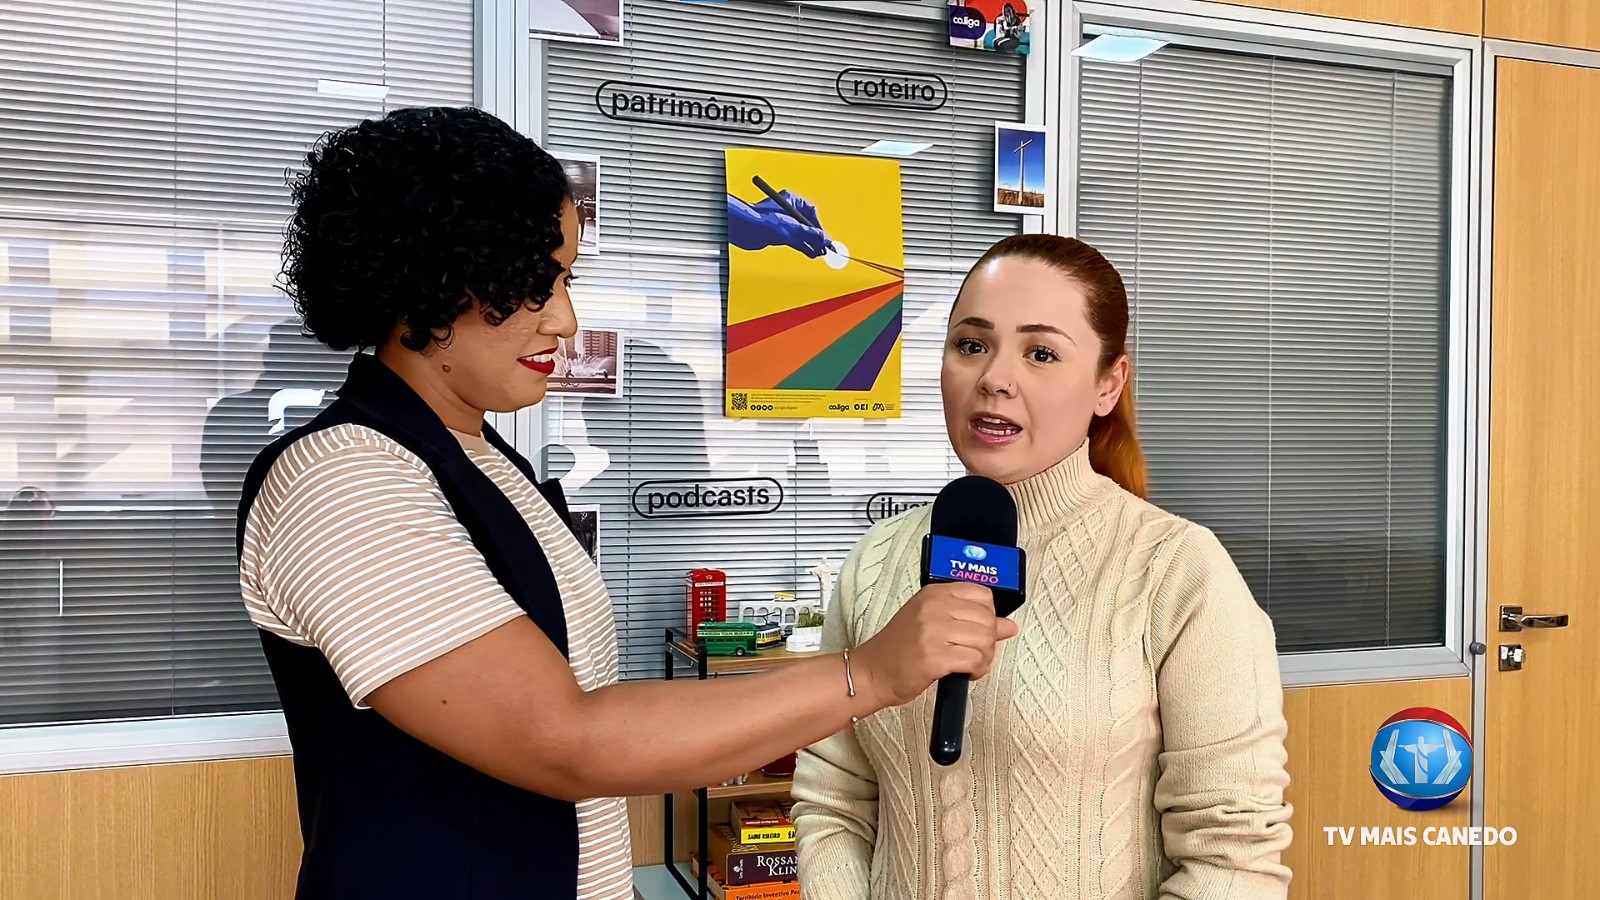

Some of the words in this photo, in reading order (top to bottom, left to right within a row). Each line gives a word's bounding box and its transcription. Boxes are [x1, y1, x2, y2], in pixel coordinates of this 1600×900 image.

[853, 75, 937, 102] roteiro
[611, 88, 764, 126] patrimônio
[647, 484, 770, 513] podcasts
[949, 559, 967, 569] TV
[968, 563, 998, 575] MAIS
[949, 569, 999, 584] CANEDO
[763, 890, 790, 899] Inventivo
